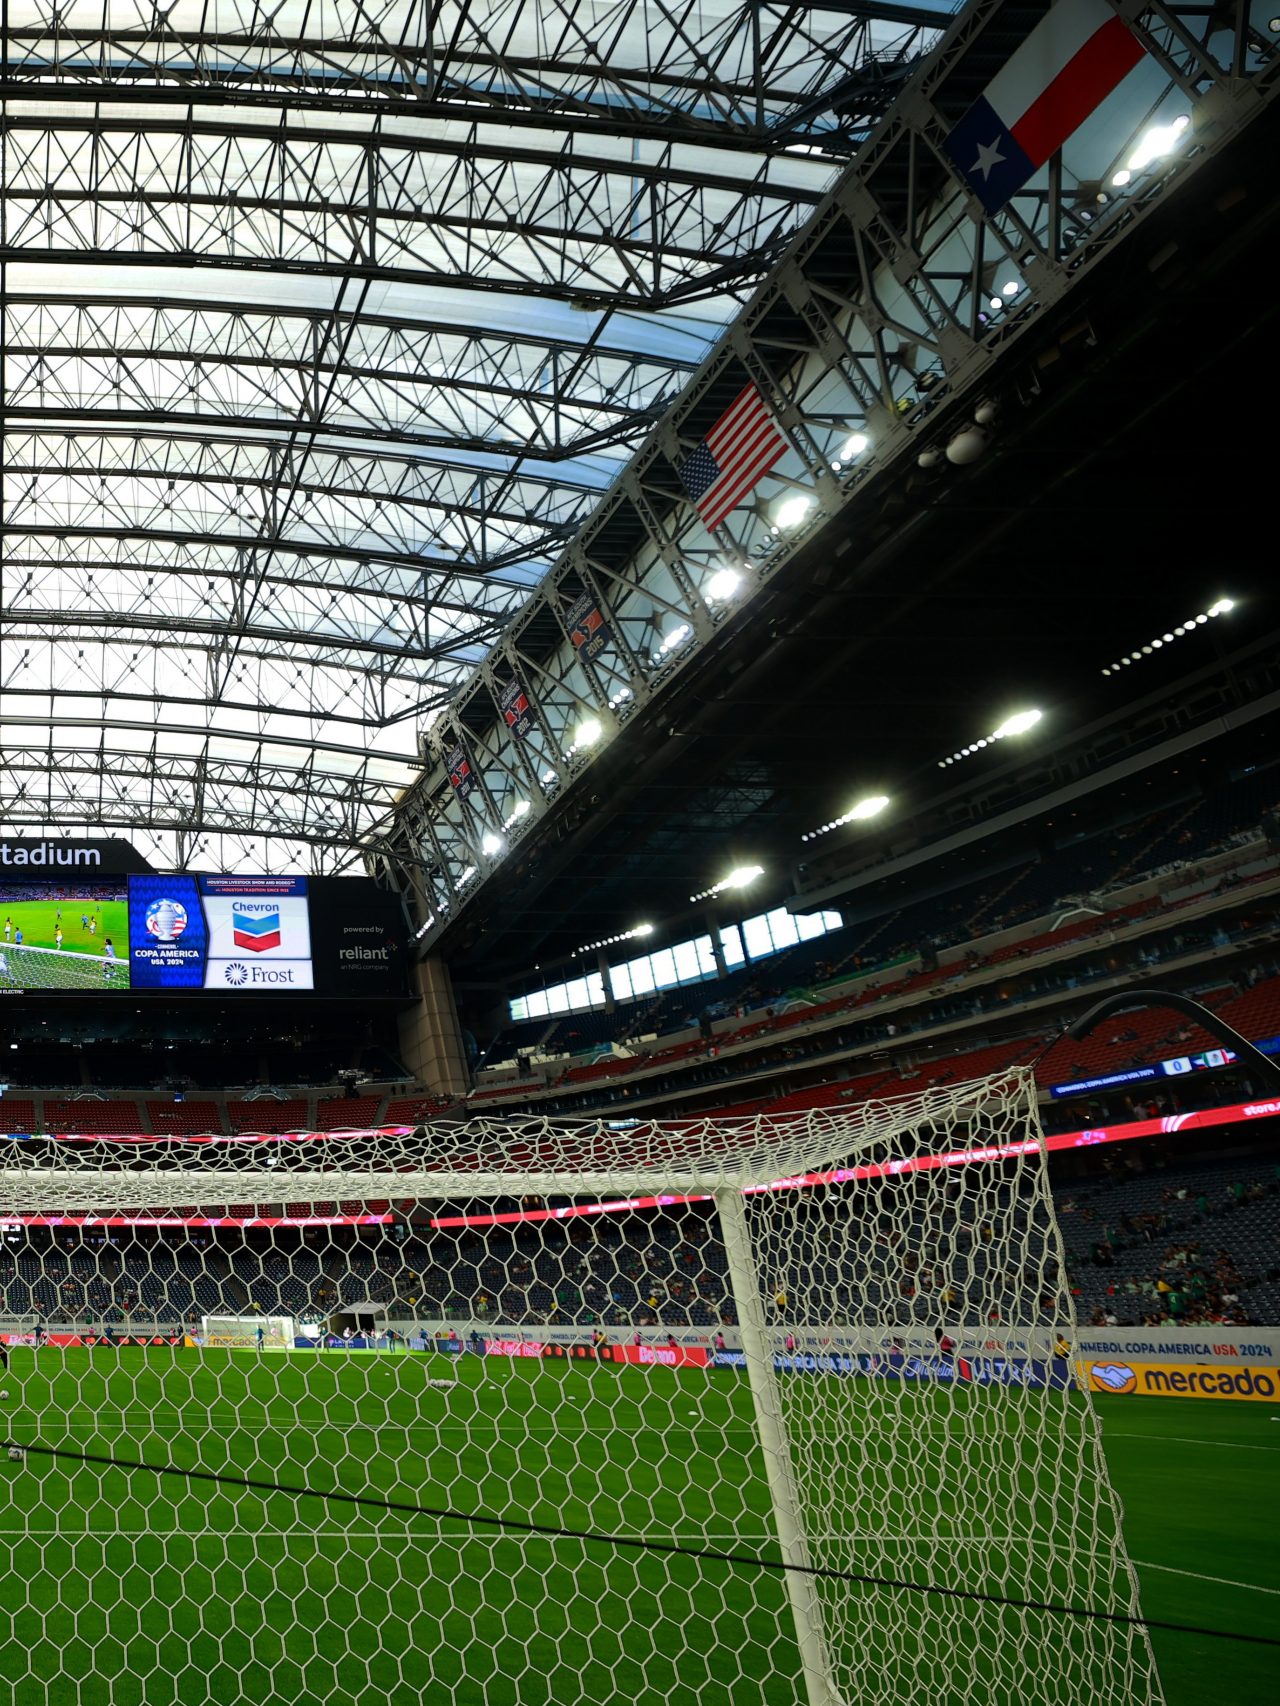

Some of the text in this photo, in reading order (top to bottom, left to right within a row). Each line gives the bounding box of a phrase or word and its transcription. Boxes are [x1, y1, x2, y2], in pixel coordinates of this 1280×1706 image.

[586, 635, 604, 657] 2015
[232, 902, 279, 912] Chevron
[343, 925, 384, 934] powered by
[135, 950, 200, 958] COPA AMERICA
[339, 946, 389, 960] reliant
[252, 966, 295, 983] Frost
[1173, 1060, 1182, 1071] 0
[1125, 1342, 1156, 1354] COPA
[1158, 1342, 1211, 1355] AMERICA
[1212, 1344, 1238, 1357] USA
[1240, 1344, 1272, 1357] 2024
[1144, 1368, 1275, 1397] mercado
